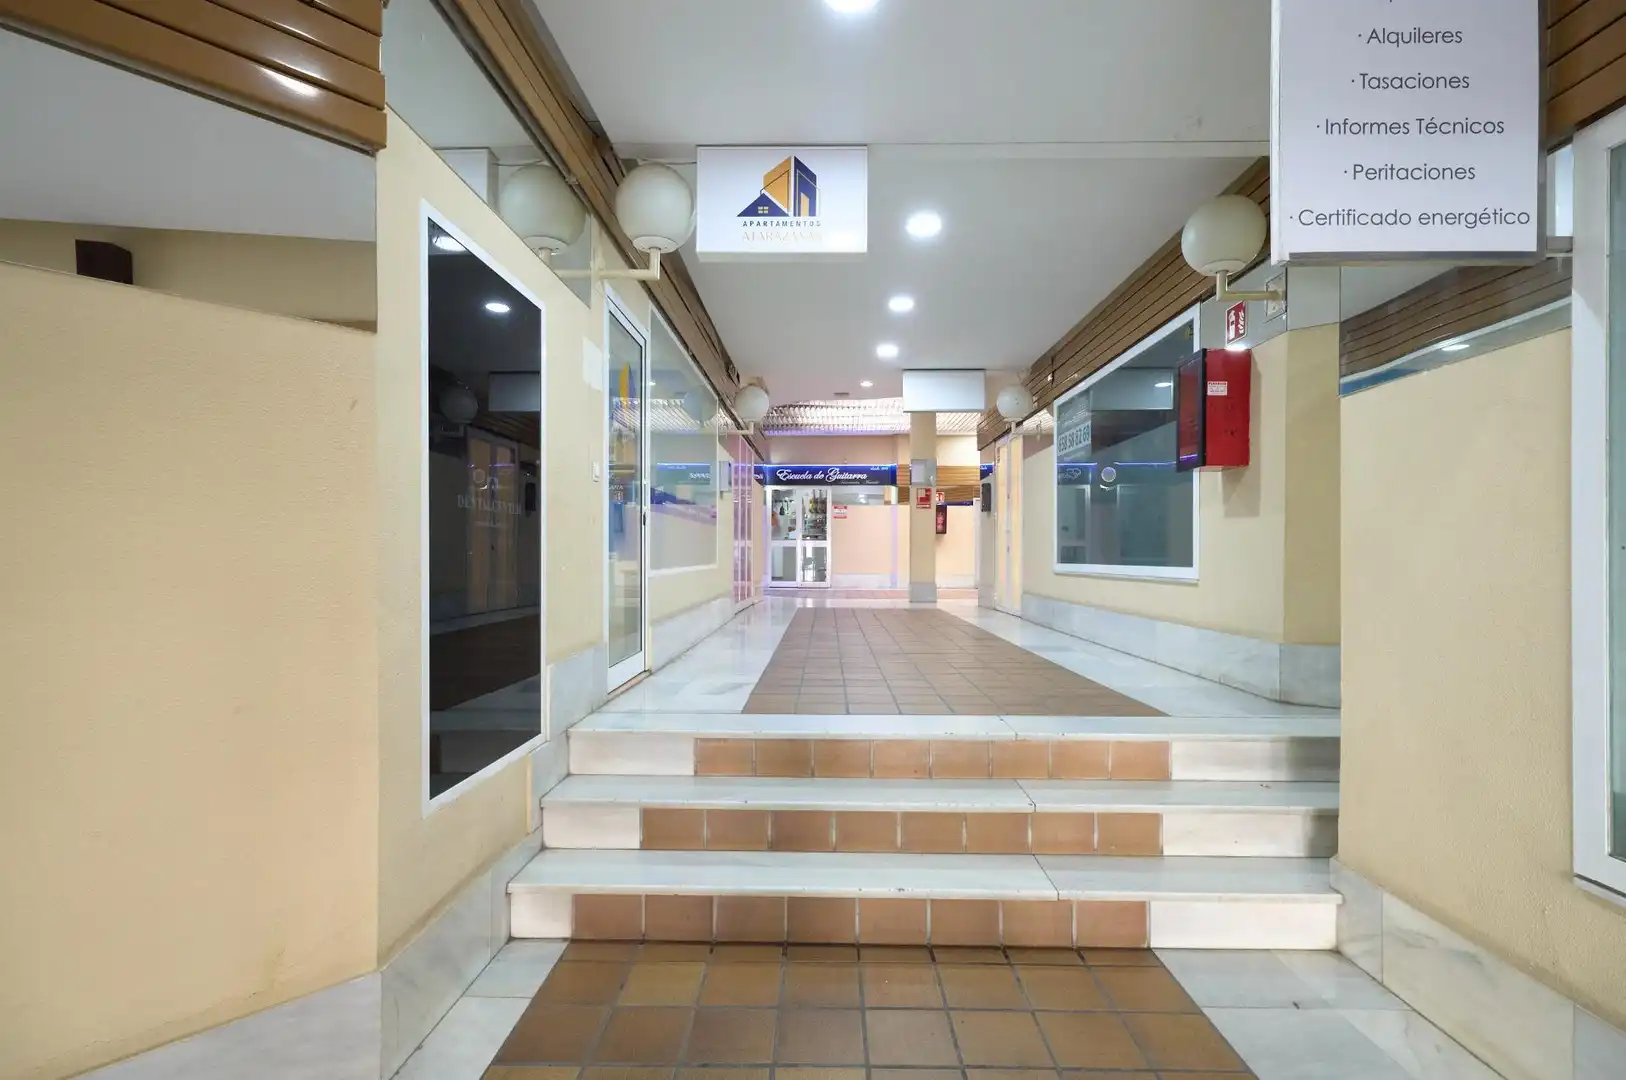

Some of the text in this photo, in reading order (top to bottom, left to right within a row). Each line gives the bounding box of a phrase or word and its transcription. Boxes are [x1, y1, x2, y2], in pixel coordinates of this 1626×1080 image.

[1366, 27, 1463, 48] Alquileres
[1359, 72, 1470, 90] Tasaciones
[1325, 116, 1505, 135] Informes Técnicos
[1353, 163, 1476, 180] Peritaciones
[742, 220, 822, 228] APARTAMENTOS
[1298, 207, 1531, 229] Certificado energético
[776, 469, 812, 480] Escuela
[813, 470, 824, 480] de
[825, 467, 868, 482] Guitarra
